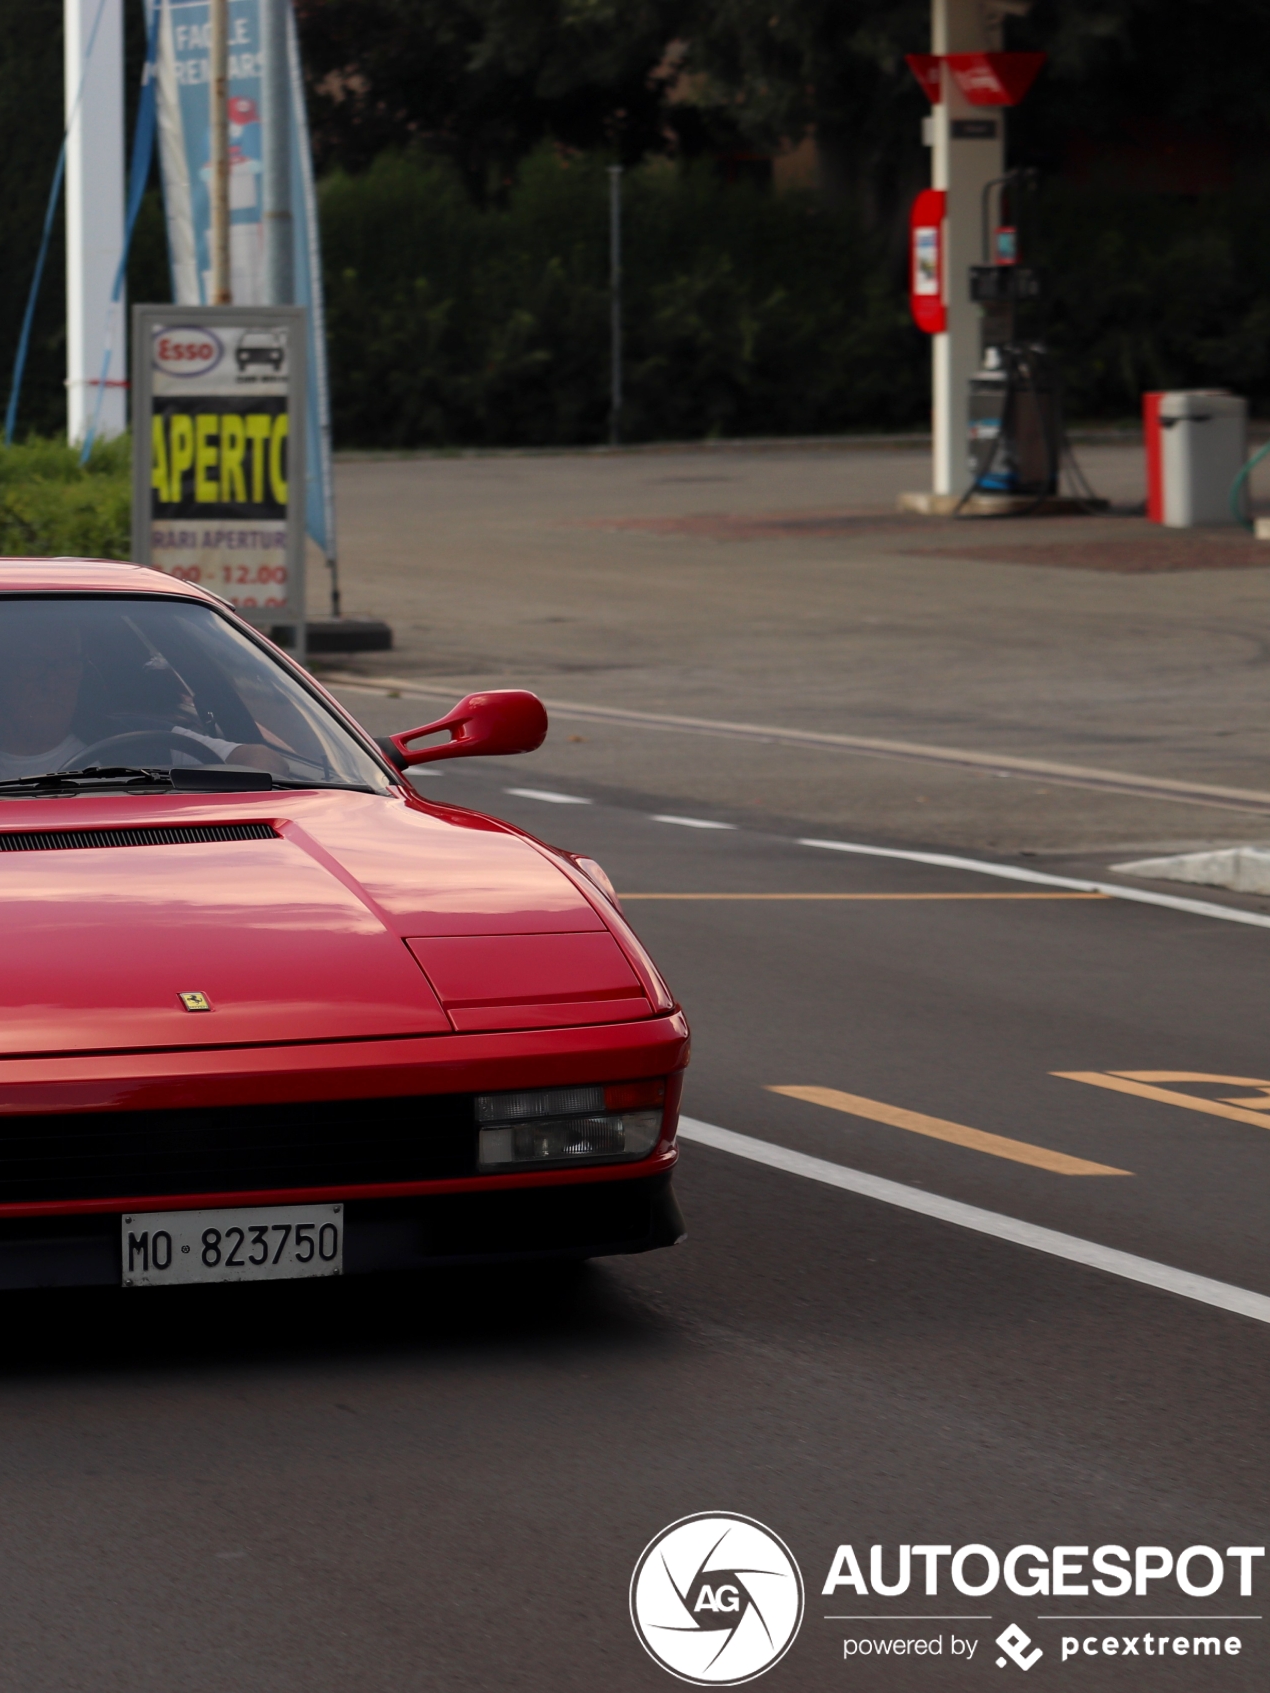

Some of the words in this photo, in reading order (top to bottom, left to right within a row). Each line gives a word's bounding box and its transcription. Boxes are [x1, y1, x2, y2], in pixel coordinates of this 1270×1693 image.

[157, 338, 214, 362] Esso
[222, 565, 287, 584] 12.00
[128, 1230, 172, 1272] MO
[201, 1223, 338, 1267] 823750
